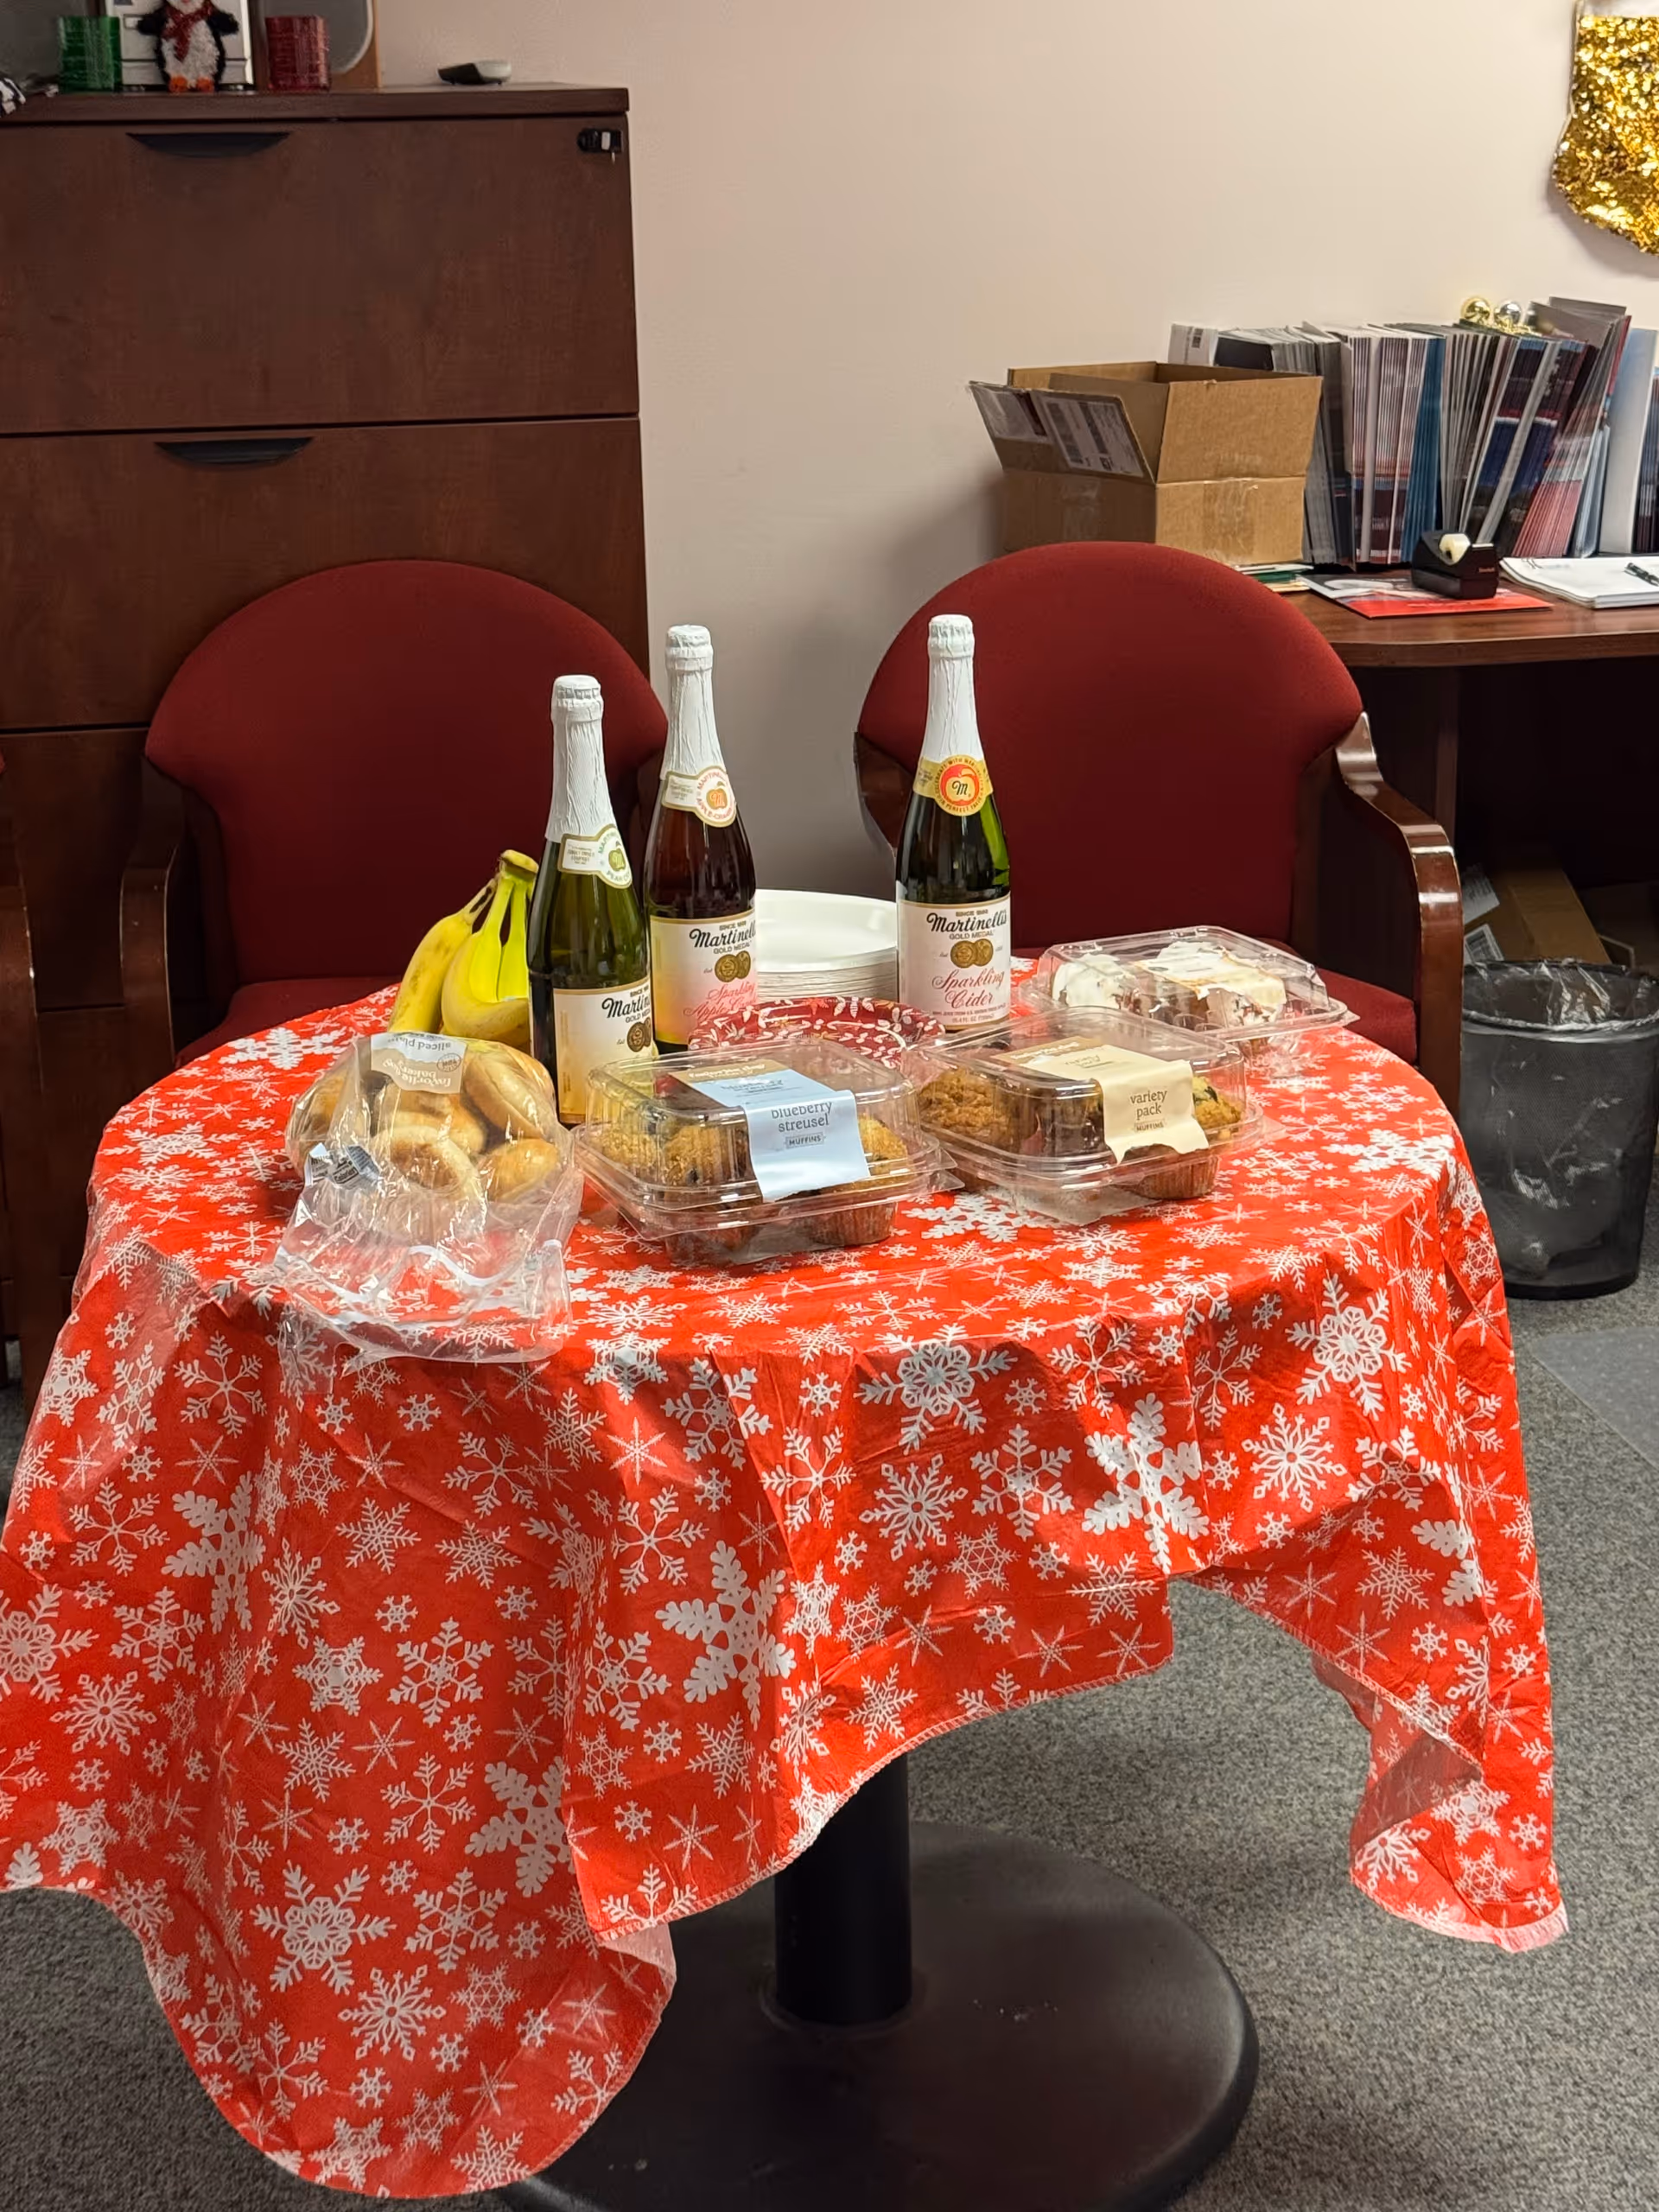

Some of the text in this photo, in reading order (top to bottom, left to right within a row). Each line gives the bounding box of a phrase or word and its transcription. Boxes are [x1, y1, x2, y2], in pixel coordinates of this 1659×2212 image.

[931, 967, 1005, 993] Sparkling
[945, 989, 994, 1009] Cider
[625, 1013, 641, 1023] GOLD
[417, 1040, 451, 1051] sliced
[397, 1059, 436, 1078] bakery
[401, 1073, 451, 1087] favorite
[1130, 1090, 1167, 1103] variety
[771, 1102, 832, 1119] blueberry
[1136, 1102, 1162, 1121] pack
[779, 1112, 830, 1133] streusel
[789, 1135, 822, 1146] MUFFINS
